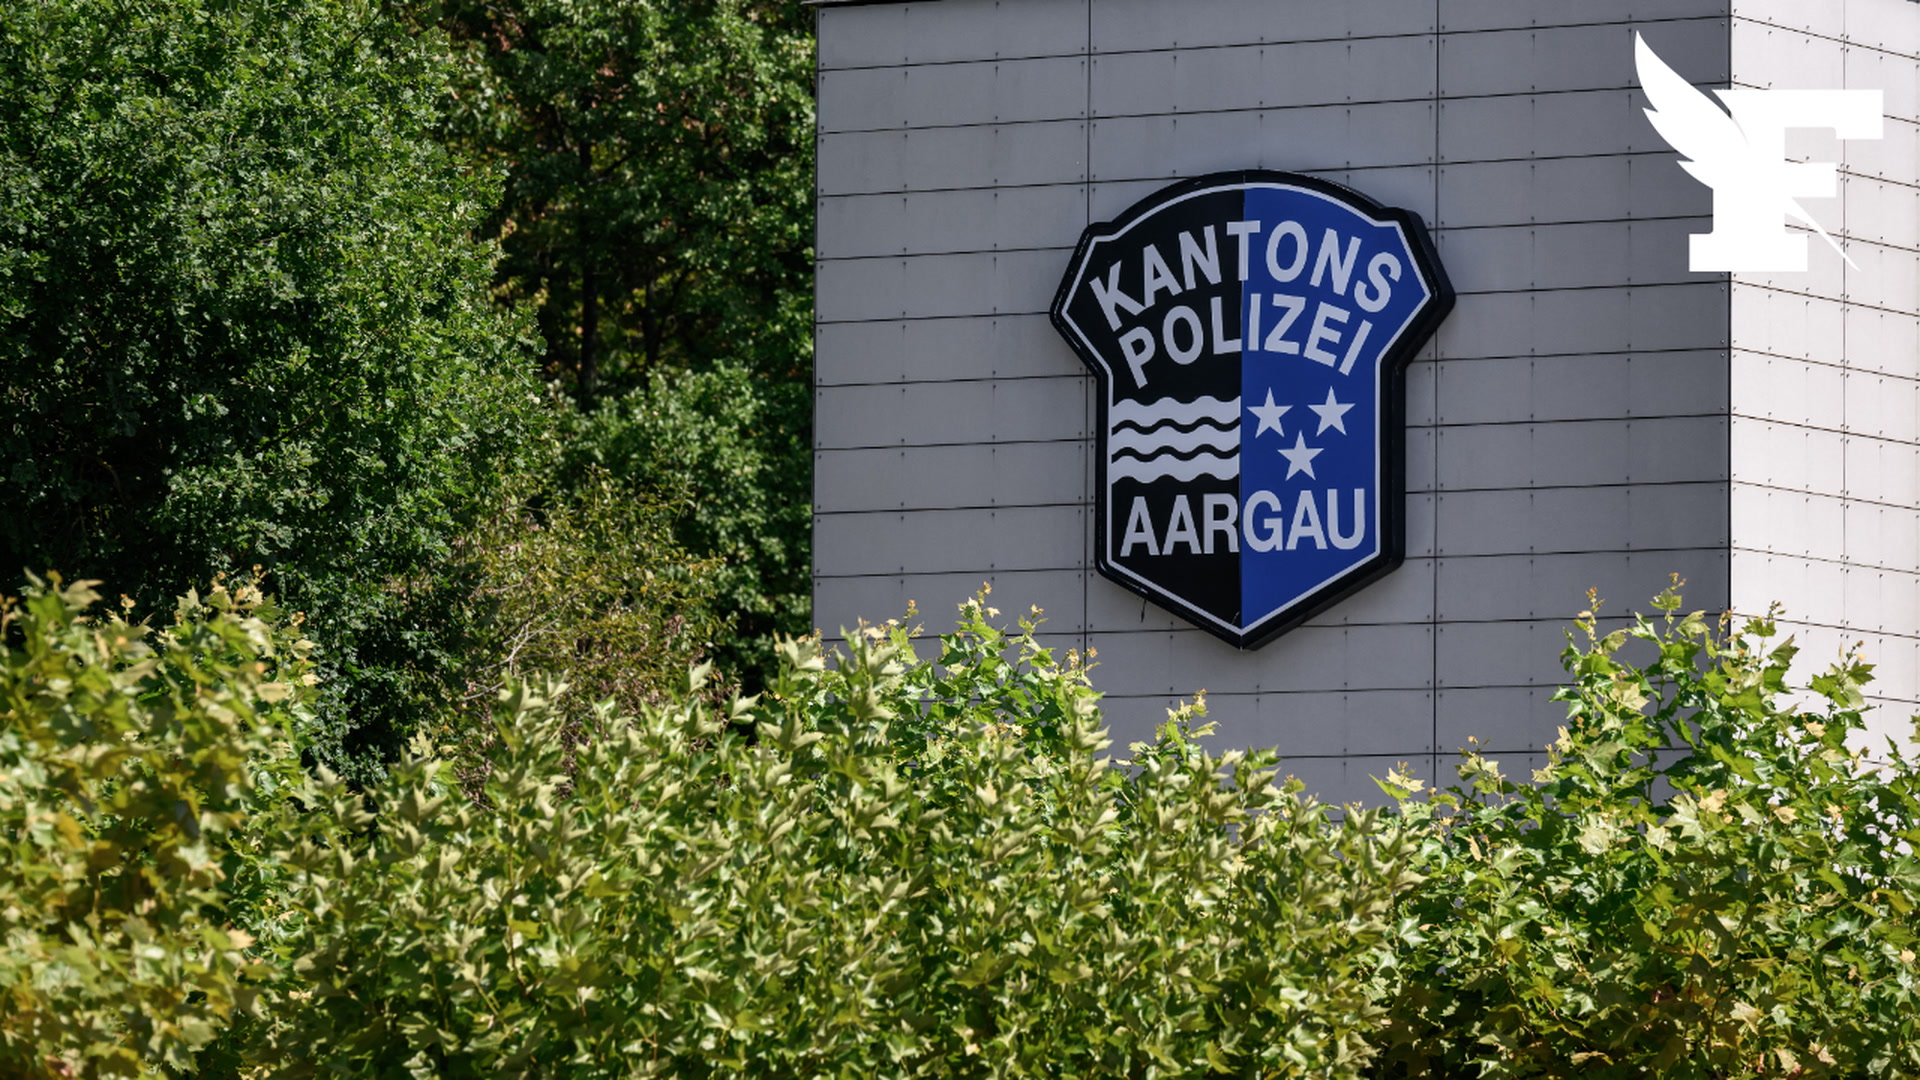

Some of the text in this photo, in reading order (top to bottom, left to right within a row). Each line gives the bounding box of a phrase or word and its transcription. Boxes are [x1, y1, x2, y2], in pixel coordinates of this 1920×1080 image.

[1090, 220, 1402, 332] KANTONS
[1118, 293, 1373, 389] POLIZEI
[1120, 488, 1366, 557] AARGAU
